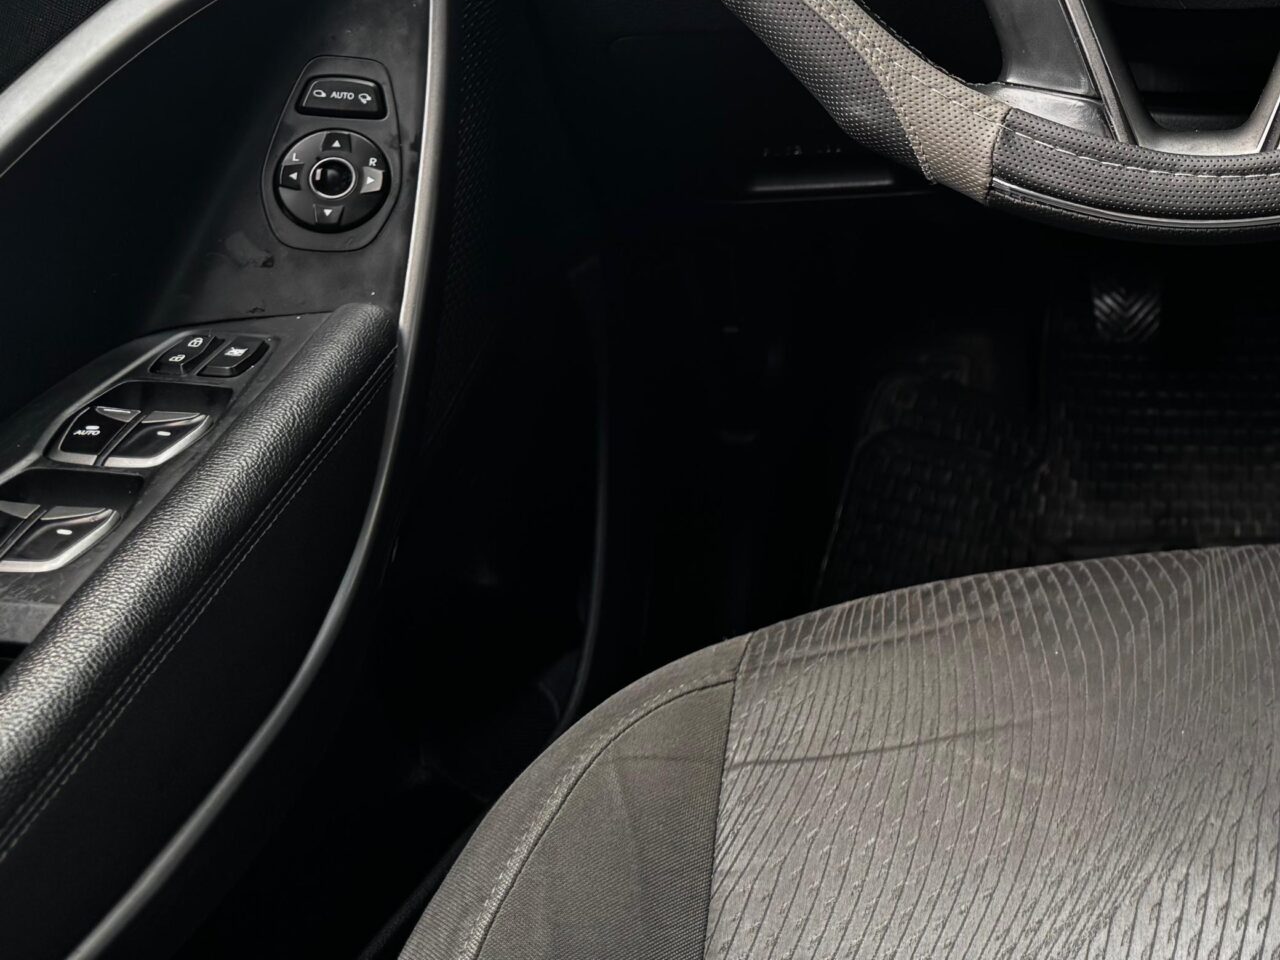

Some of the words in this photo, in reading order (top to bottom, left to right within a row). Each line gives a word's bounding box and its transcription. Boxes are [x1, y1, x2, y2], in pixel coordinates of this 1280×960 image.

[330, 92, 355, 100] AUTO
[292, 153, 300, 162] L
[369, 158, 377, 167] R
